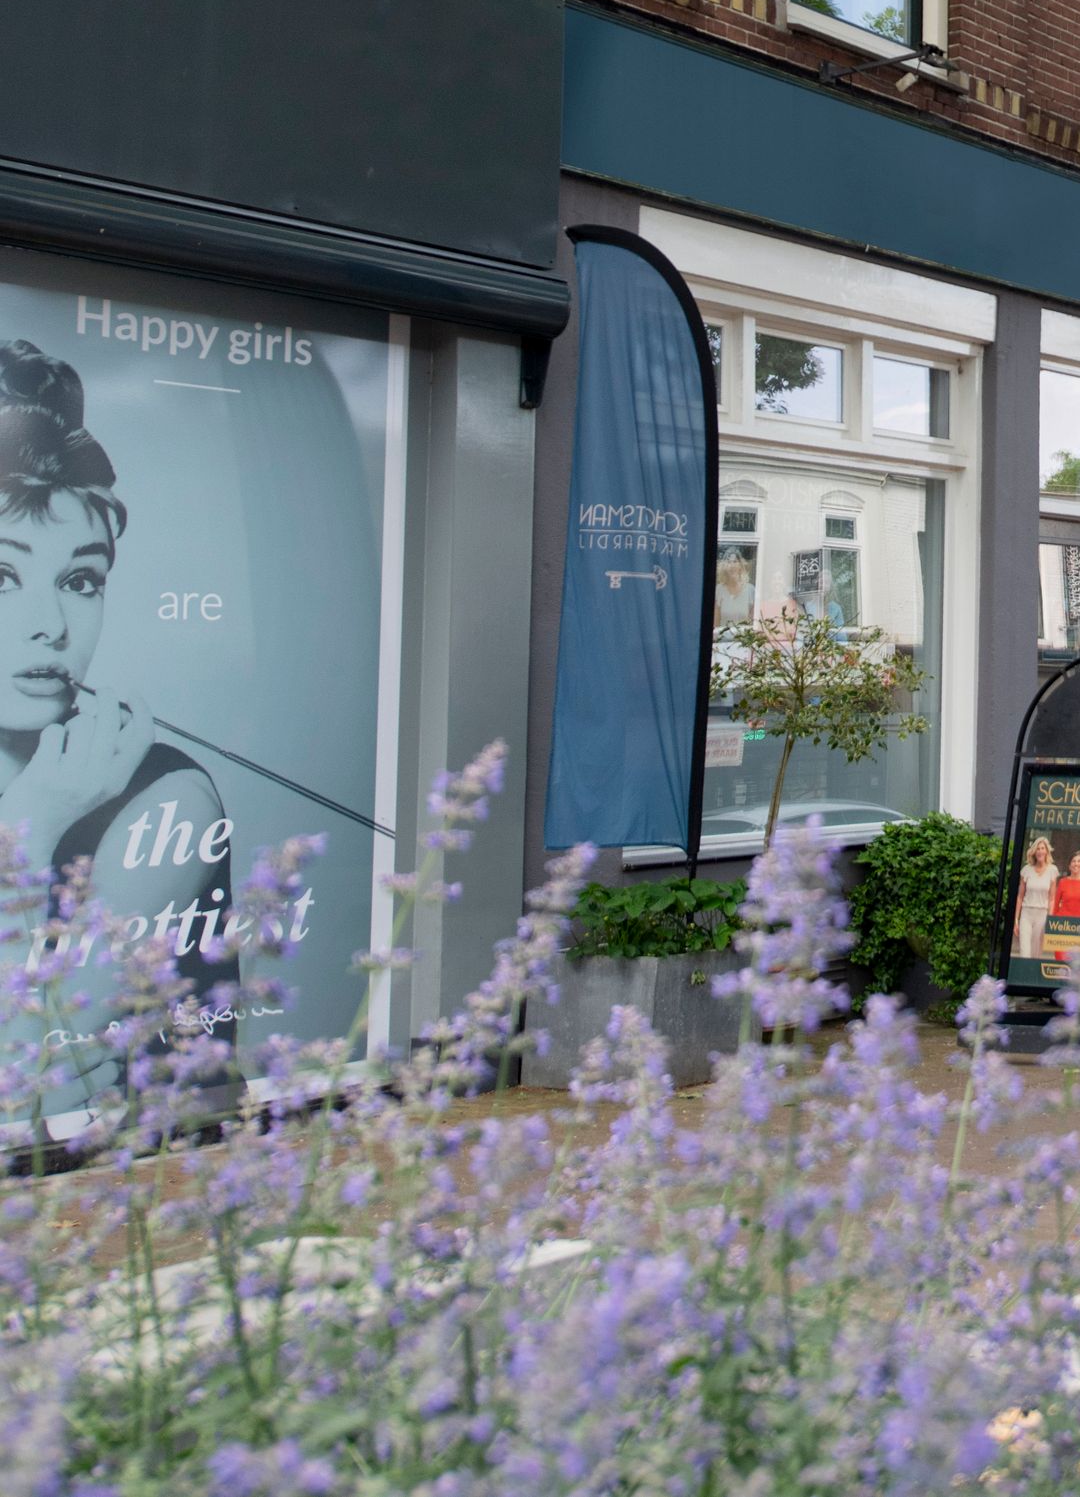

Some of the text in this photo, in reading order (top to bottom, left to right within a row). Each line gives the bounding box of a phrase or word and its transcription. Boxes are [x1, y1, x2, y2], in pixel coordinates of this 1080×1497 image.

[76, 295, 313, 366] Happy girls
[158, 591, 223, 621] are
[122, 800, 234, 870] the
